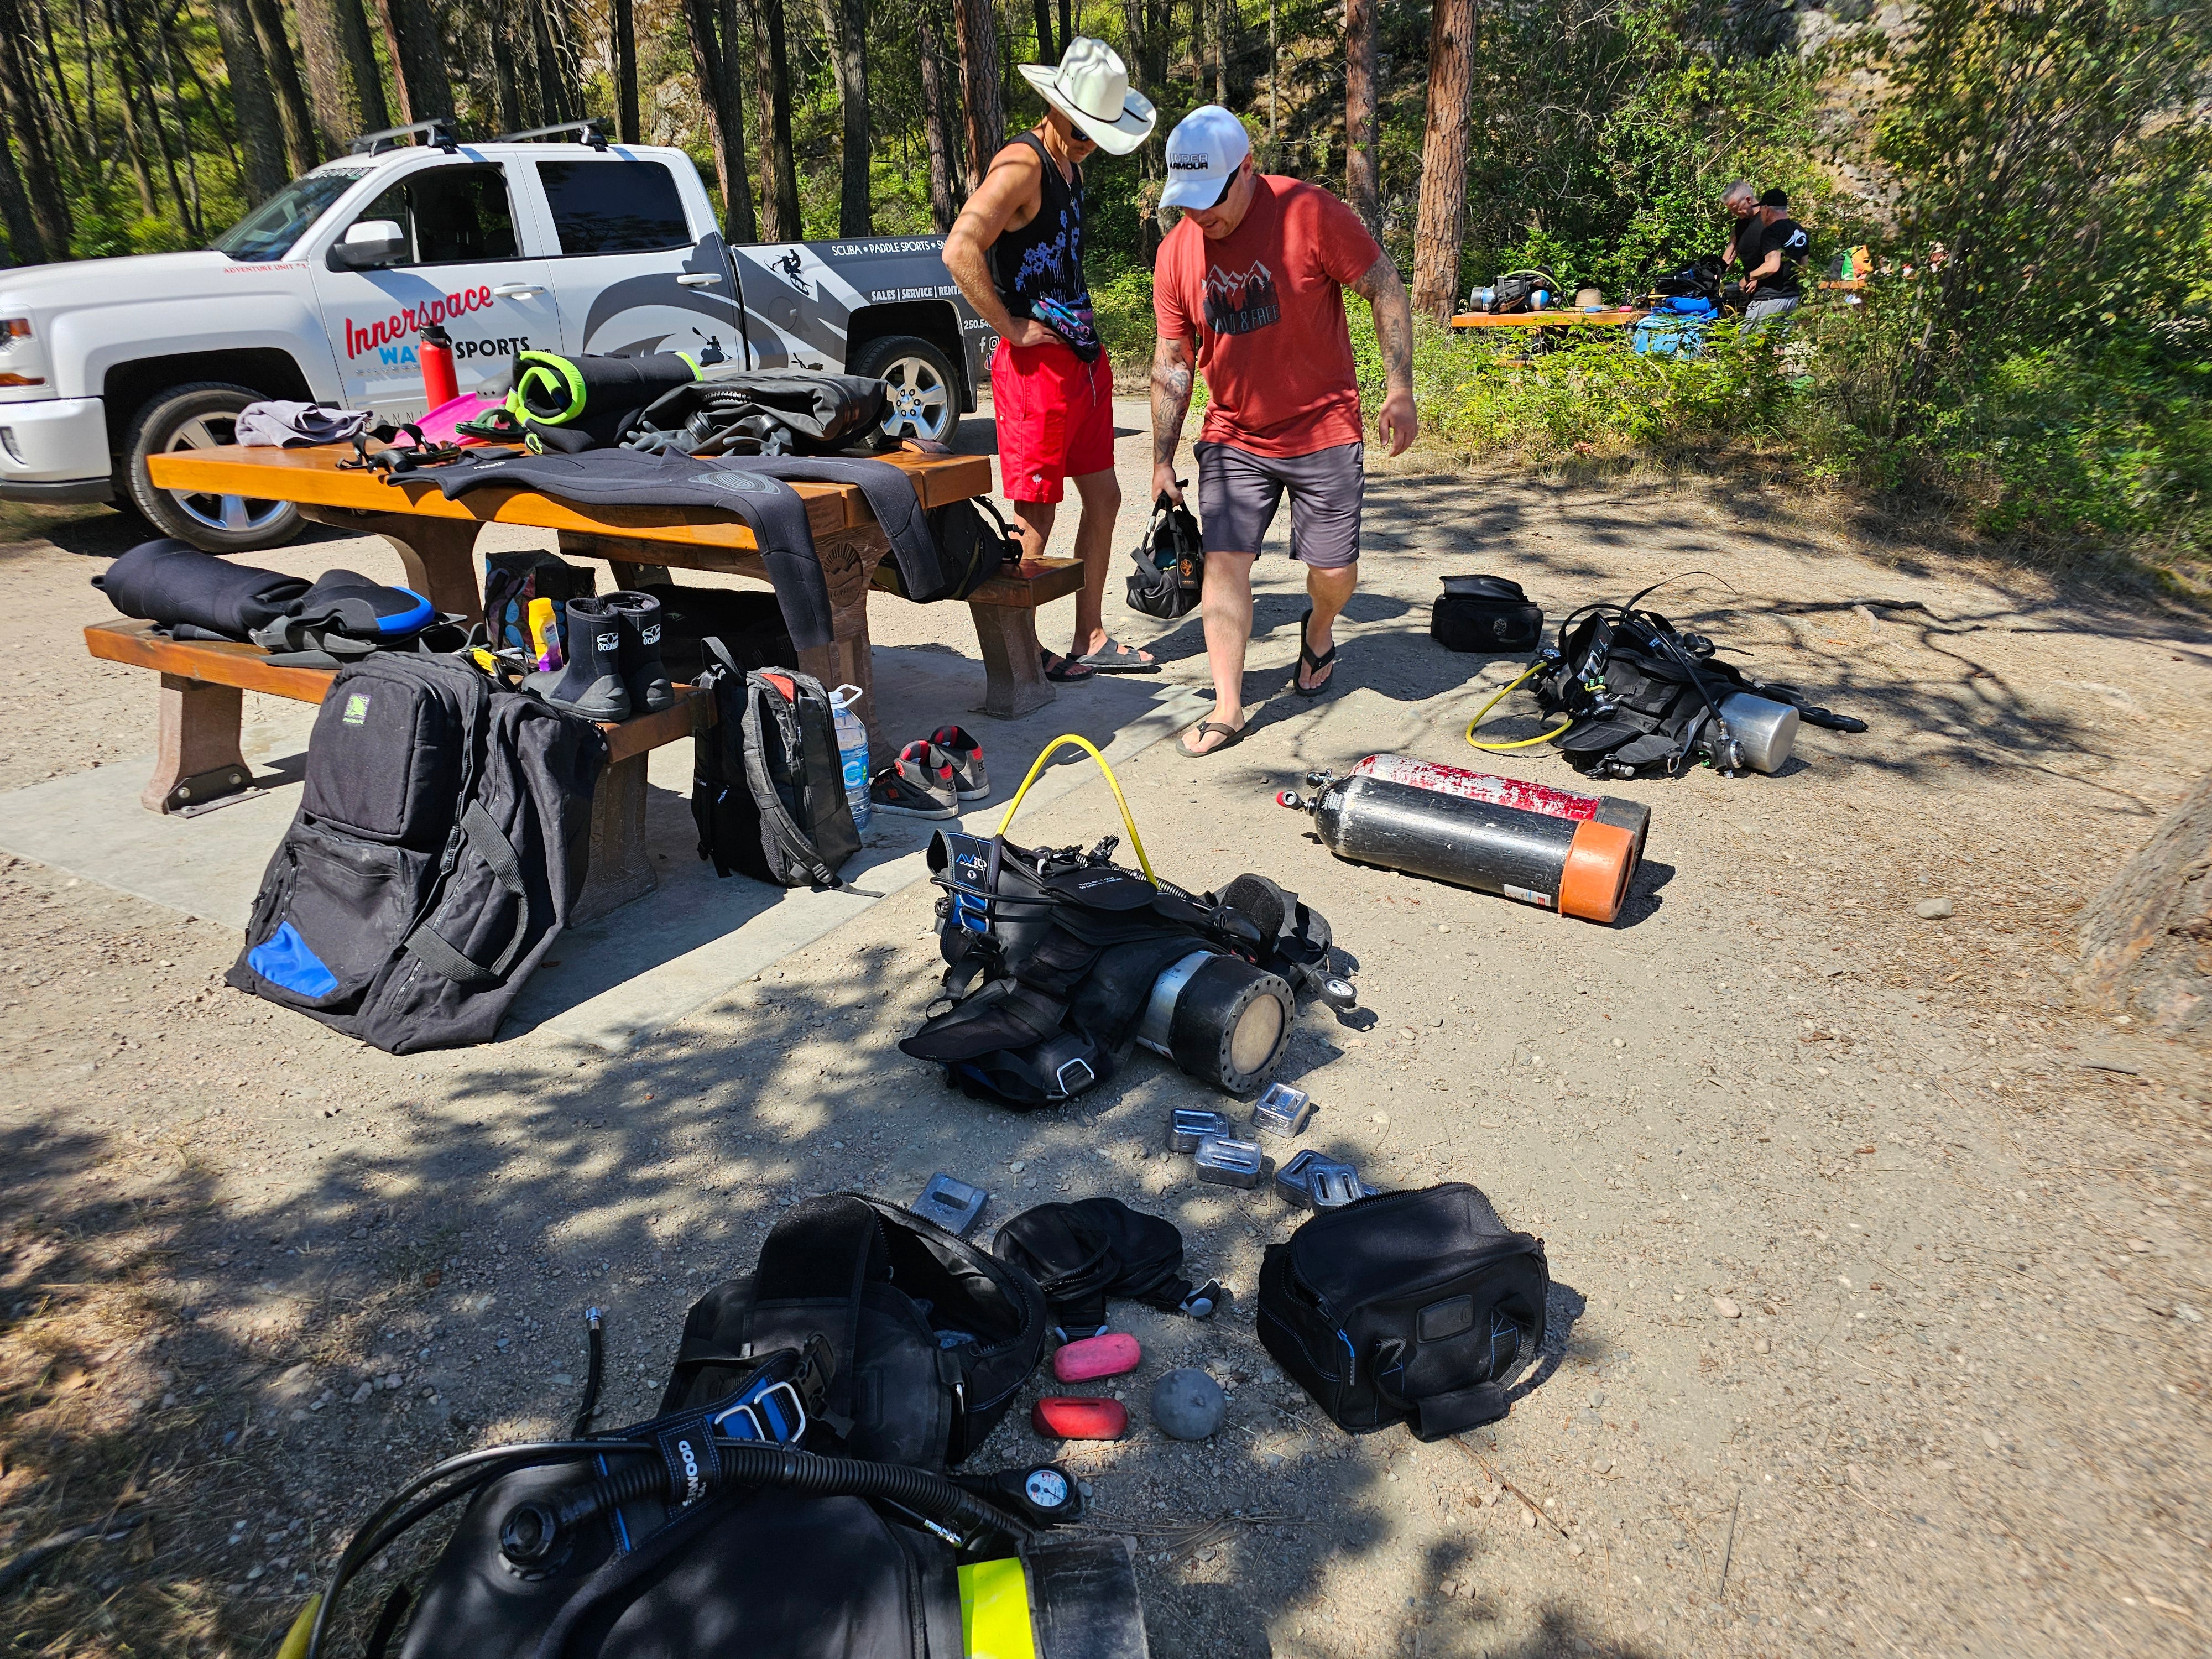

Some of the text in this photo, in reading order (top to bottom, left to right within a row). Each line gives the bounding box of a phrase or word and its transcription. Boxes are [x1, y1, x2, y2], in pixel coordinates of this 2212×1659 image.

[1170, 153, 1208, 163] UNDER
[832, 245, 863, 256] SCUBA
[869, 242, 901, 254] PADDLE
[900, 240, 930, 252] SPORTS
[224, 264, 273, 274] ADVENTURE
[871, 290, 896, 301] SALES
[901, 286, 933, 299] SERVICE
[346, 286, 493, 359] Innerspace
[1240, 311, 1249, 331] &
[1251, 305, 1280, 328] FREE
[379, 346, 420, 365] WA
[455, 337, 530, 359] SPORTS
